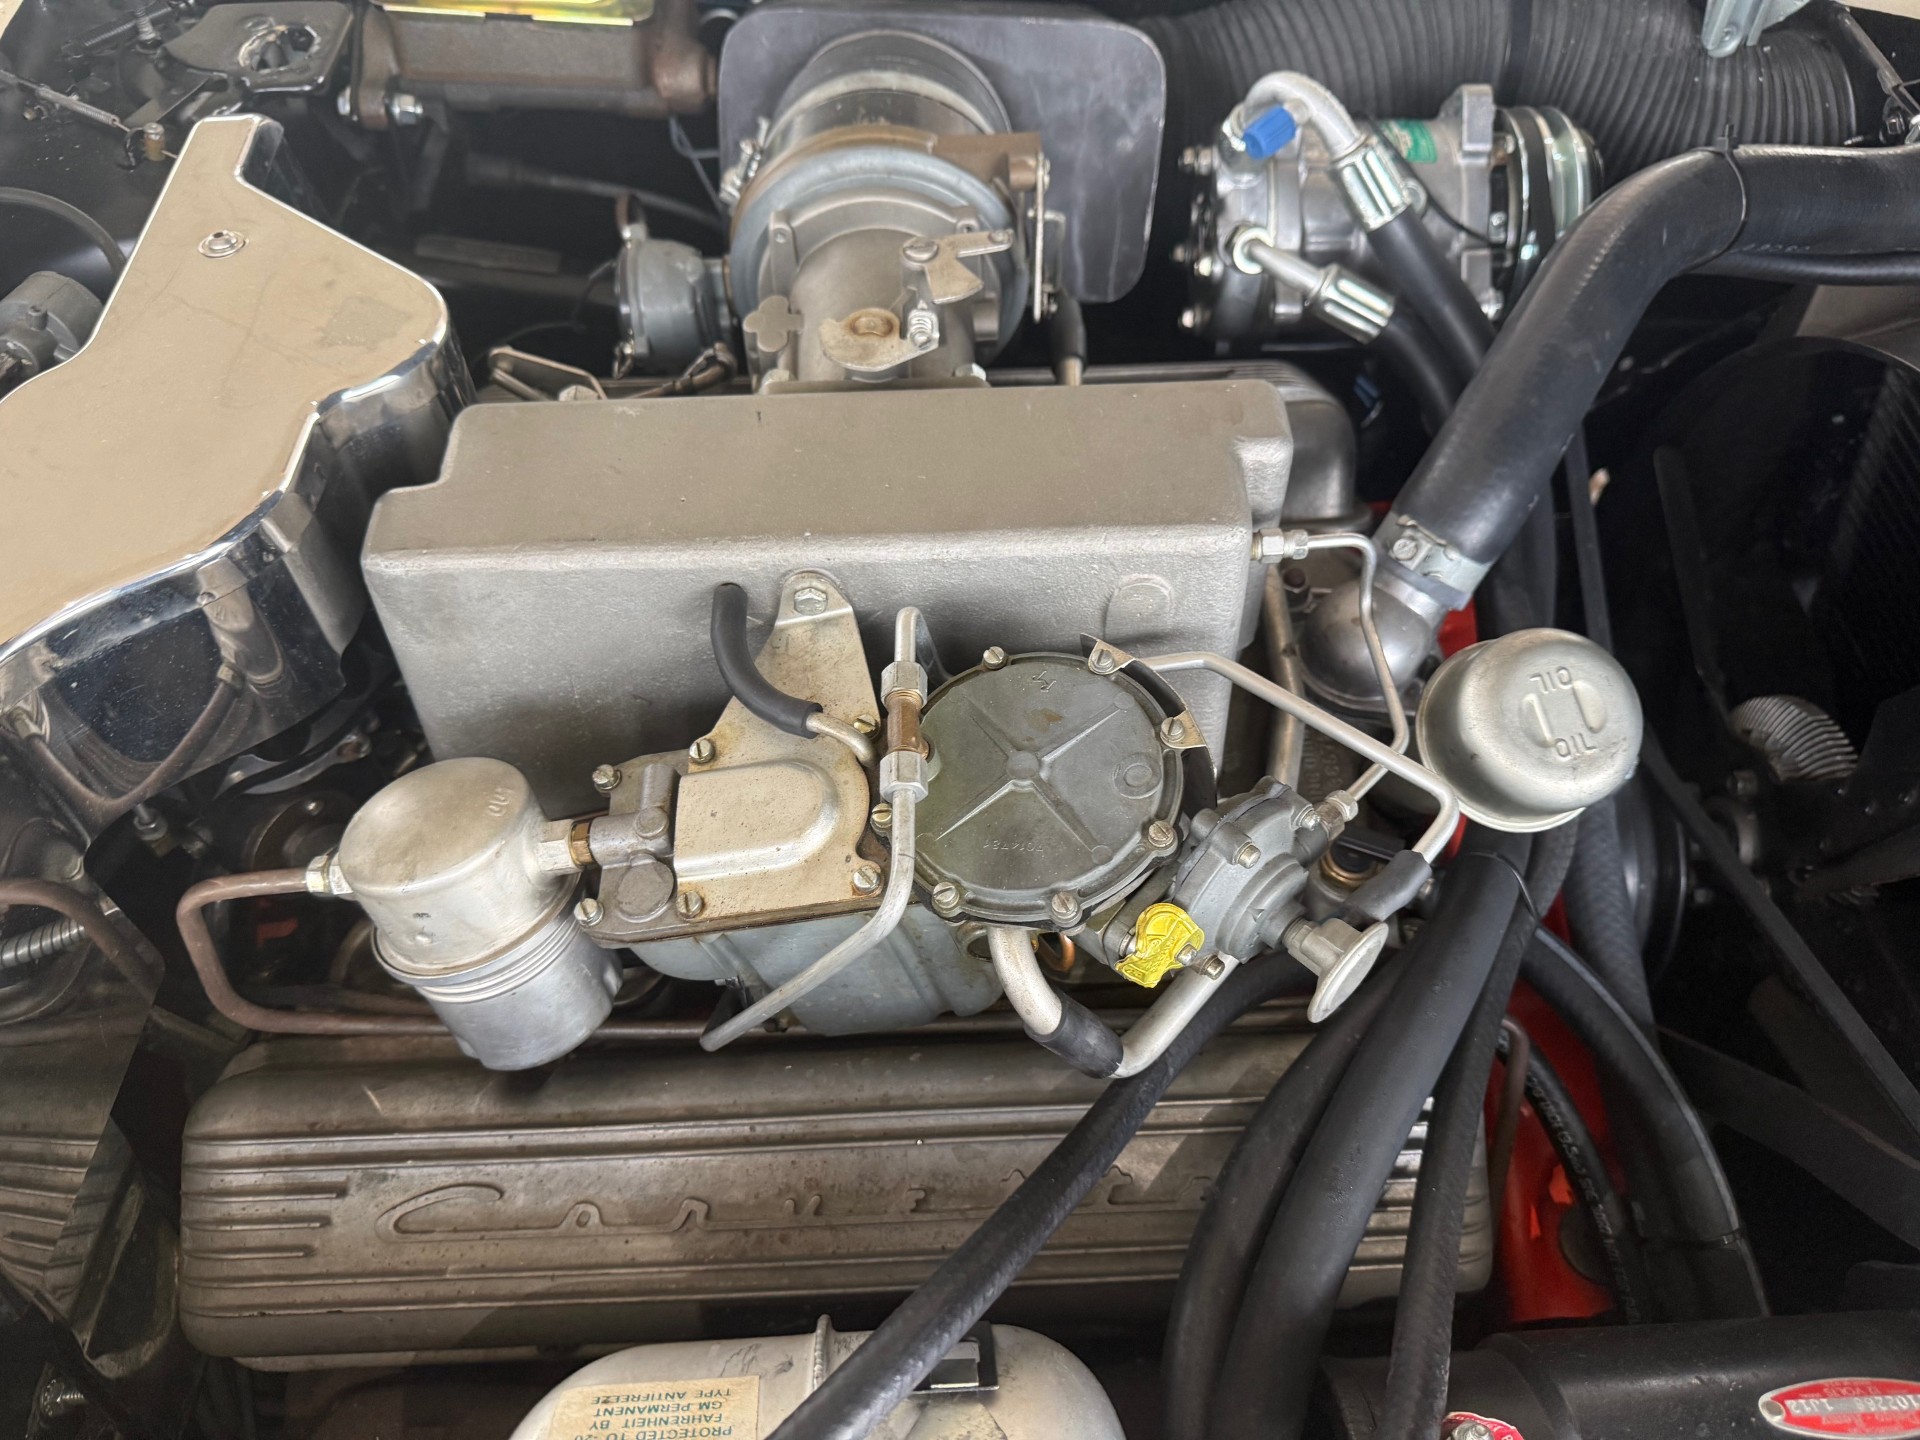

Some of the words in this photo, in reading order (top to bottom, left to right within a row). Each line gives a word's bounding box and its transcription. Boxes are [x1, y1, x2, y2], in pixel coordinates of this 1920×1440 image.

[1529, 666, 1574, 693] OIL
[1555, 732, 1598, 761] OIL
[592, 1391, 687, 1405] ANTIFREEZE
[694, 1388, 732, 1398] TYPE
[594, 1403, 691, 1418] PERMANENT
[699, 1401, 723, 1411] GM
[589, 1419, 610, 1431] BY
[621, 1413, 723, 1429] FAHRENHEIT
[636, 1425, 733, 1440] PROTECTED
